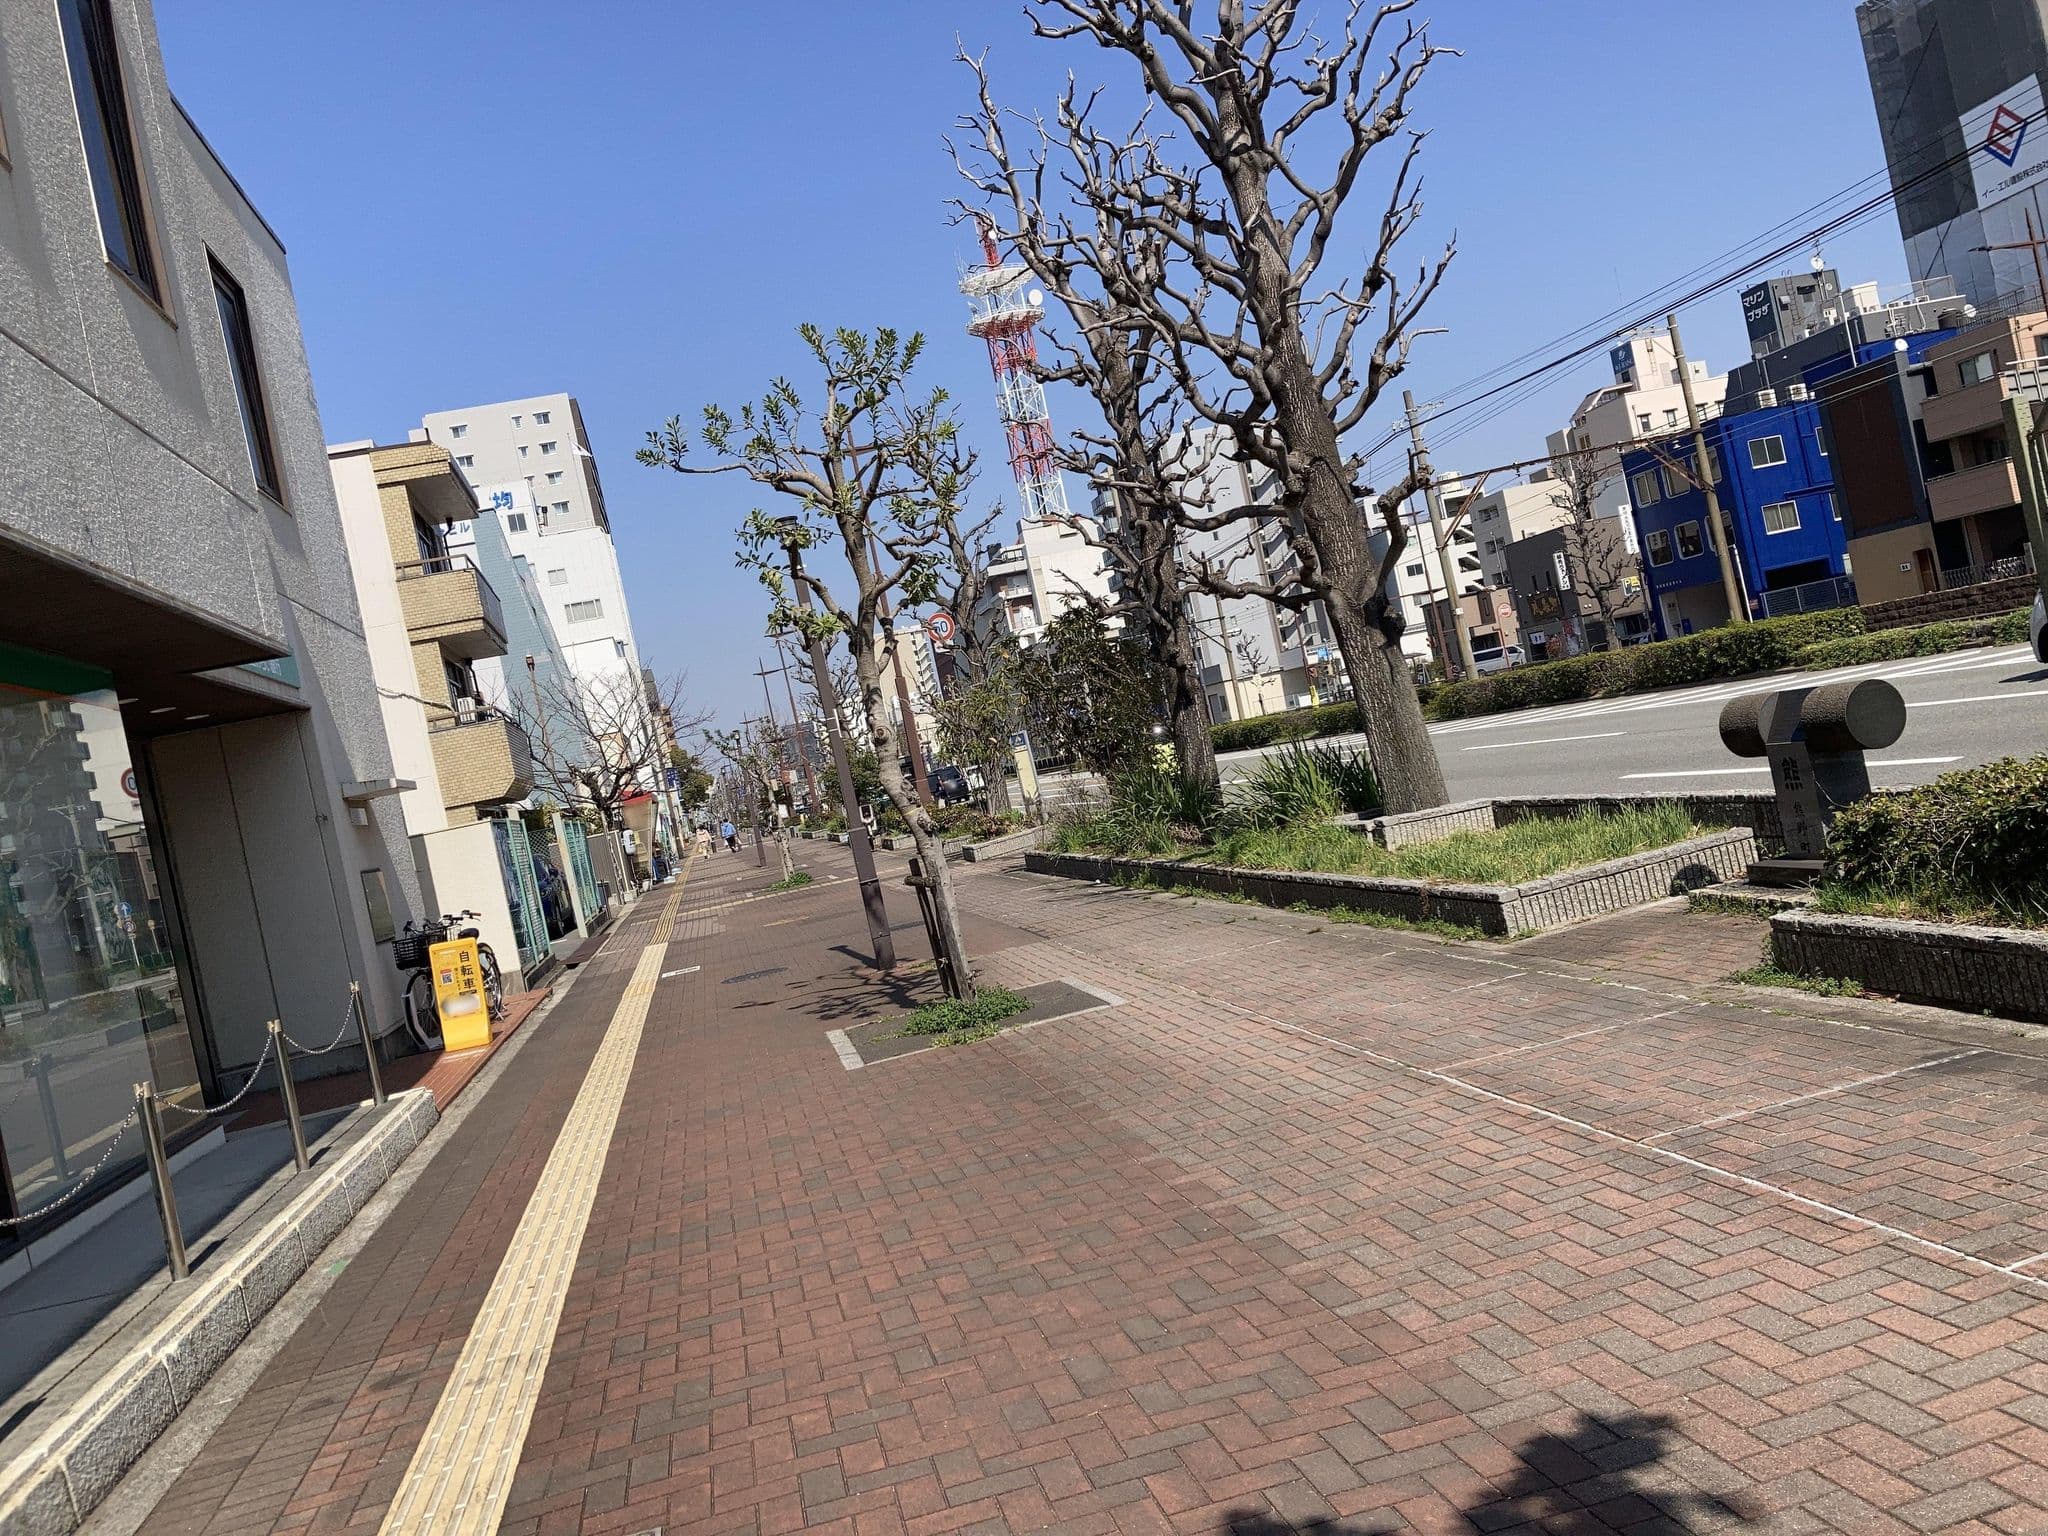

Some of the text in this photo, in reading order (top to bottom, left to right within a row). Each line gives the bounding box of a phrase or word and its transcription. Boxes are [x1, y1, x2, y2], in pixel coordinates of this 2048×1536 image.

[1747, 303, 1770, 322] プラザ
[459, 950, 476, 989] 自転車
